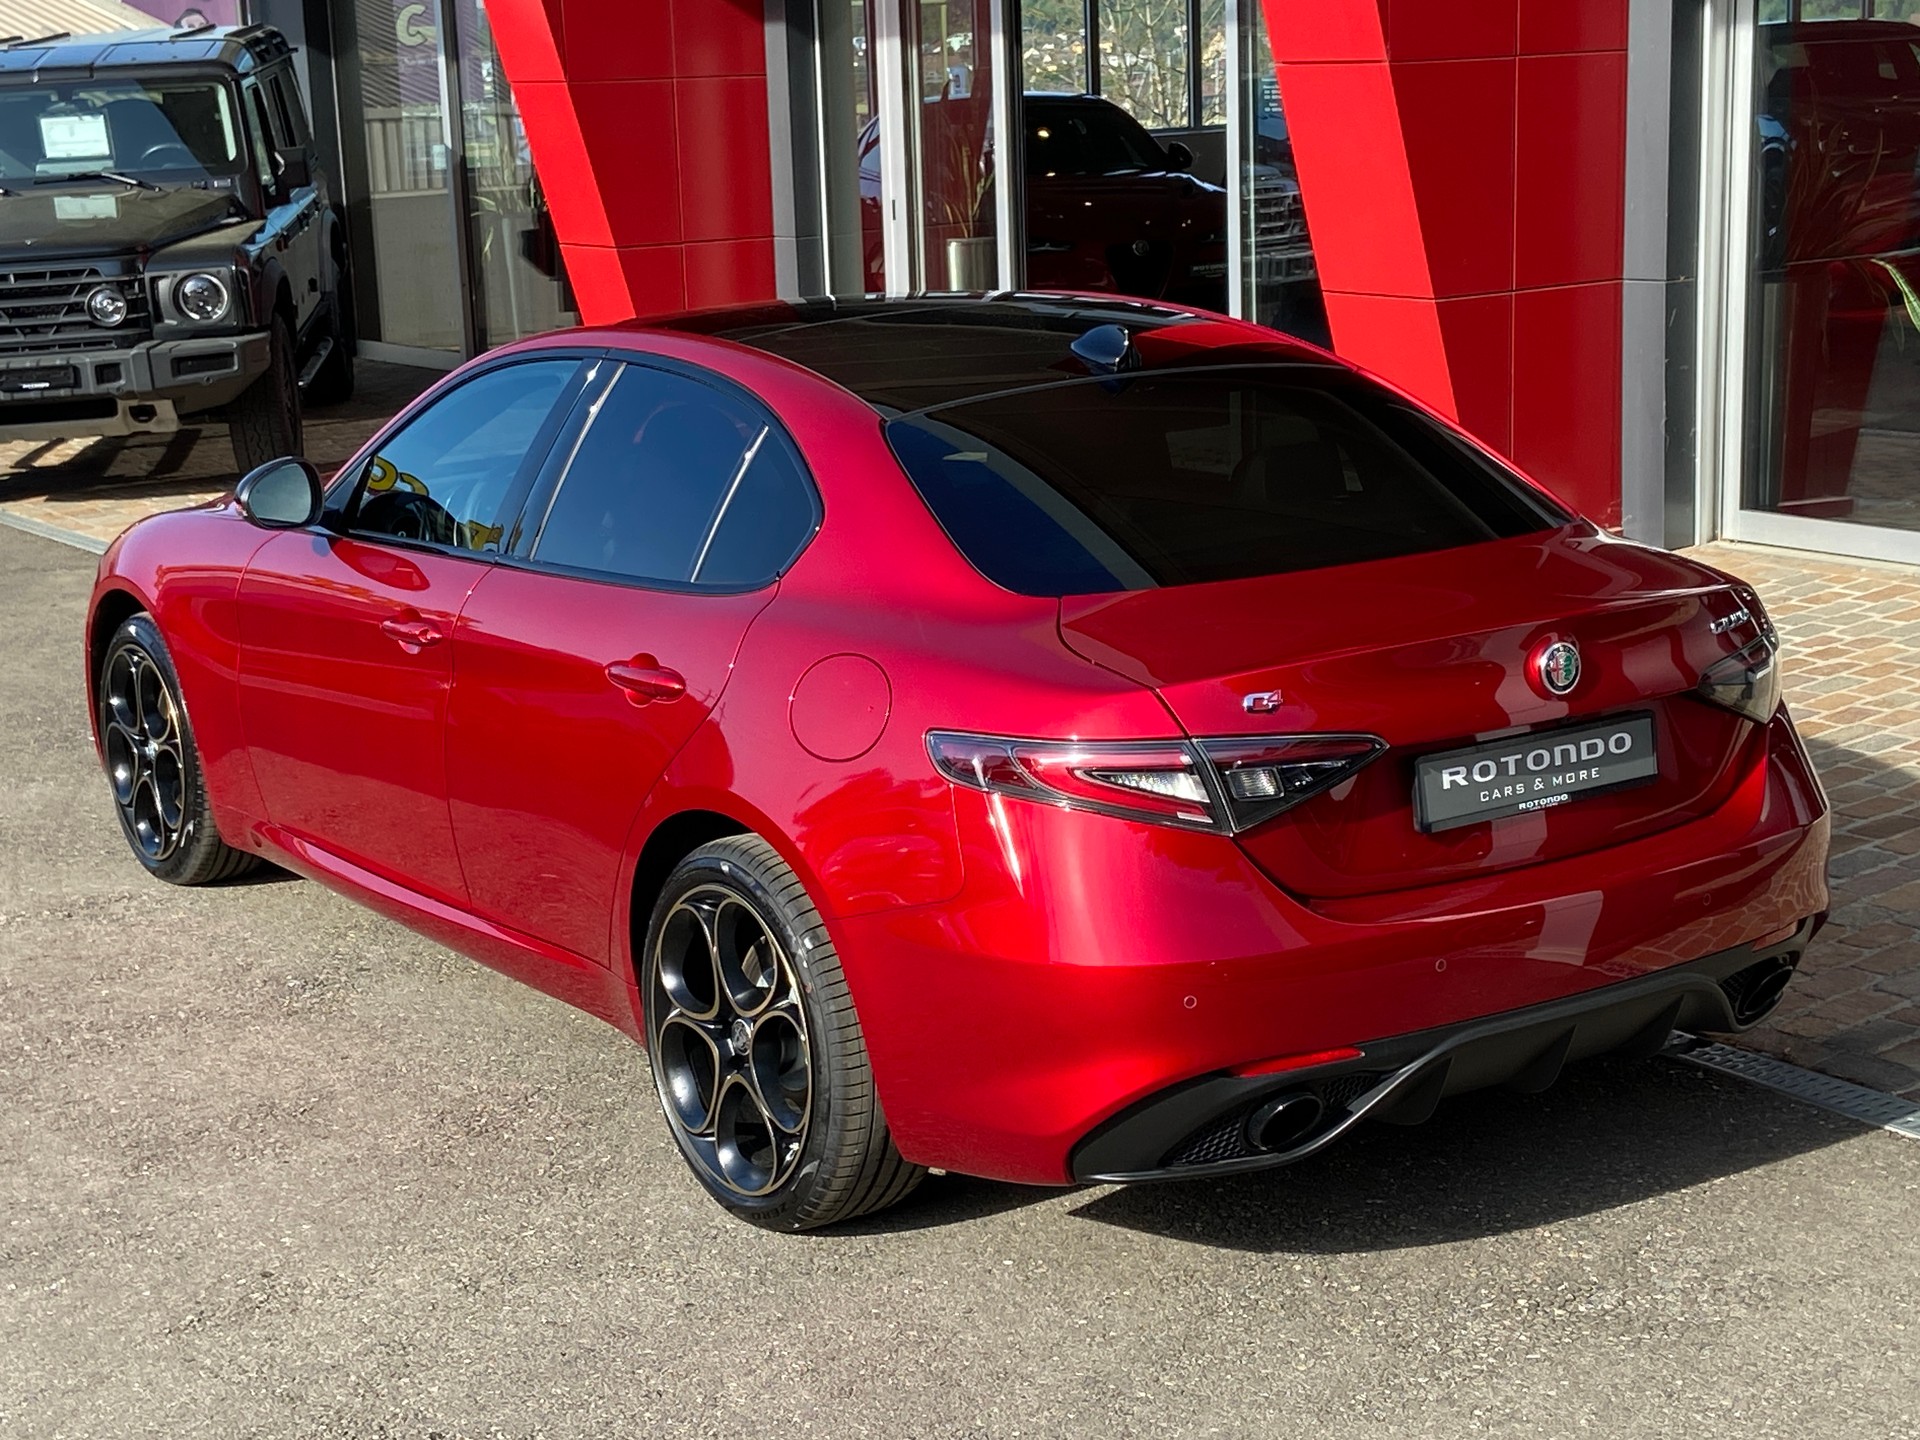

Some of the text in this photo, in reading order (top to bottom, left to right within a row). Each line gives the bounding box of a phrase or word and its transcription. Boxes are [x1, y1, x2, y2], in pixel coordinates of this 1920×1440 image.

[1442, 732, 1632, 789] ROTONDO
[1480, 767, 1600, 802] CARS & MORE
[1518, 793, 1569, 810] ROTONDO
